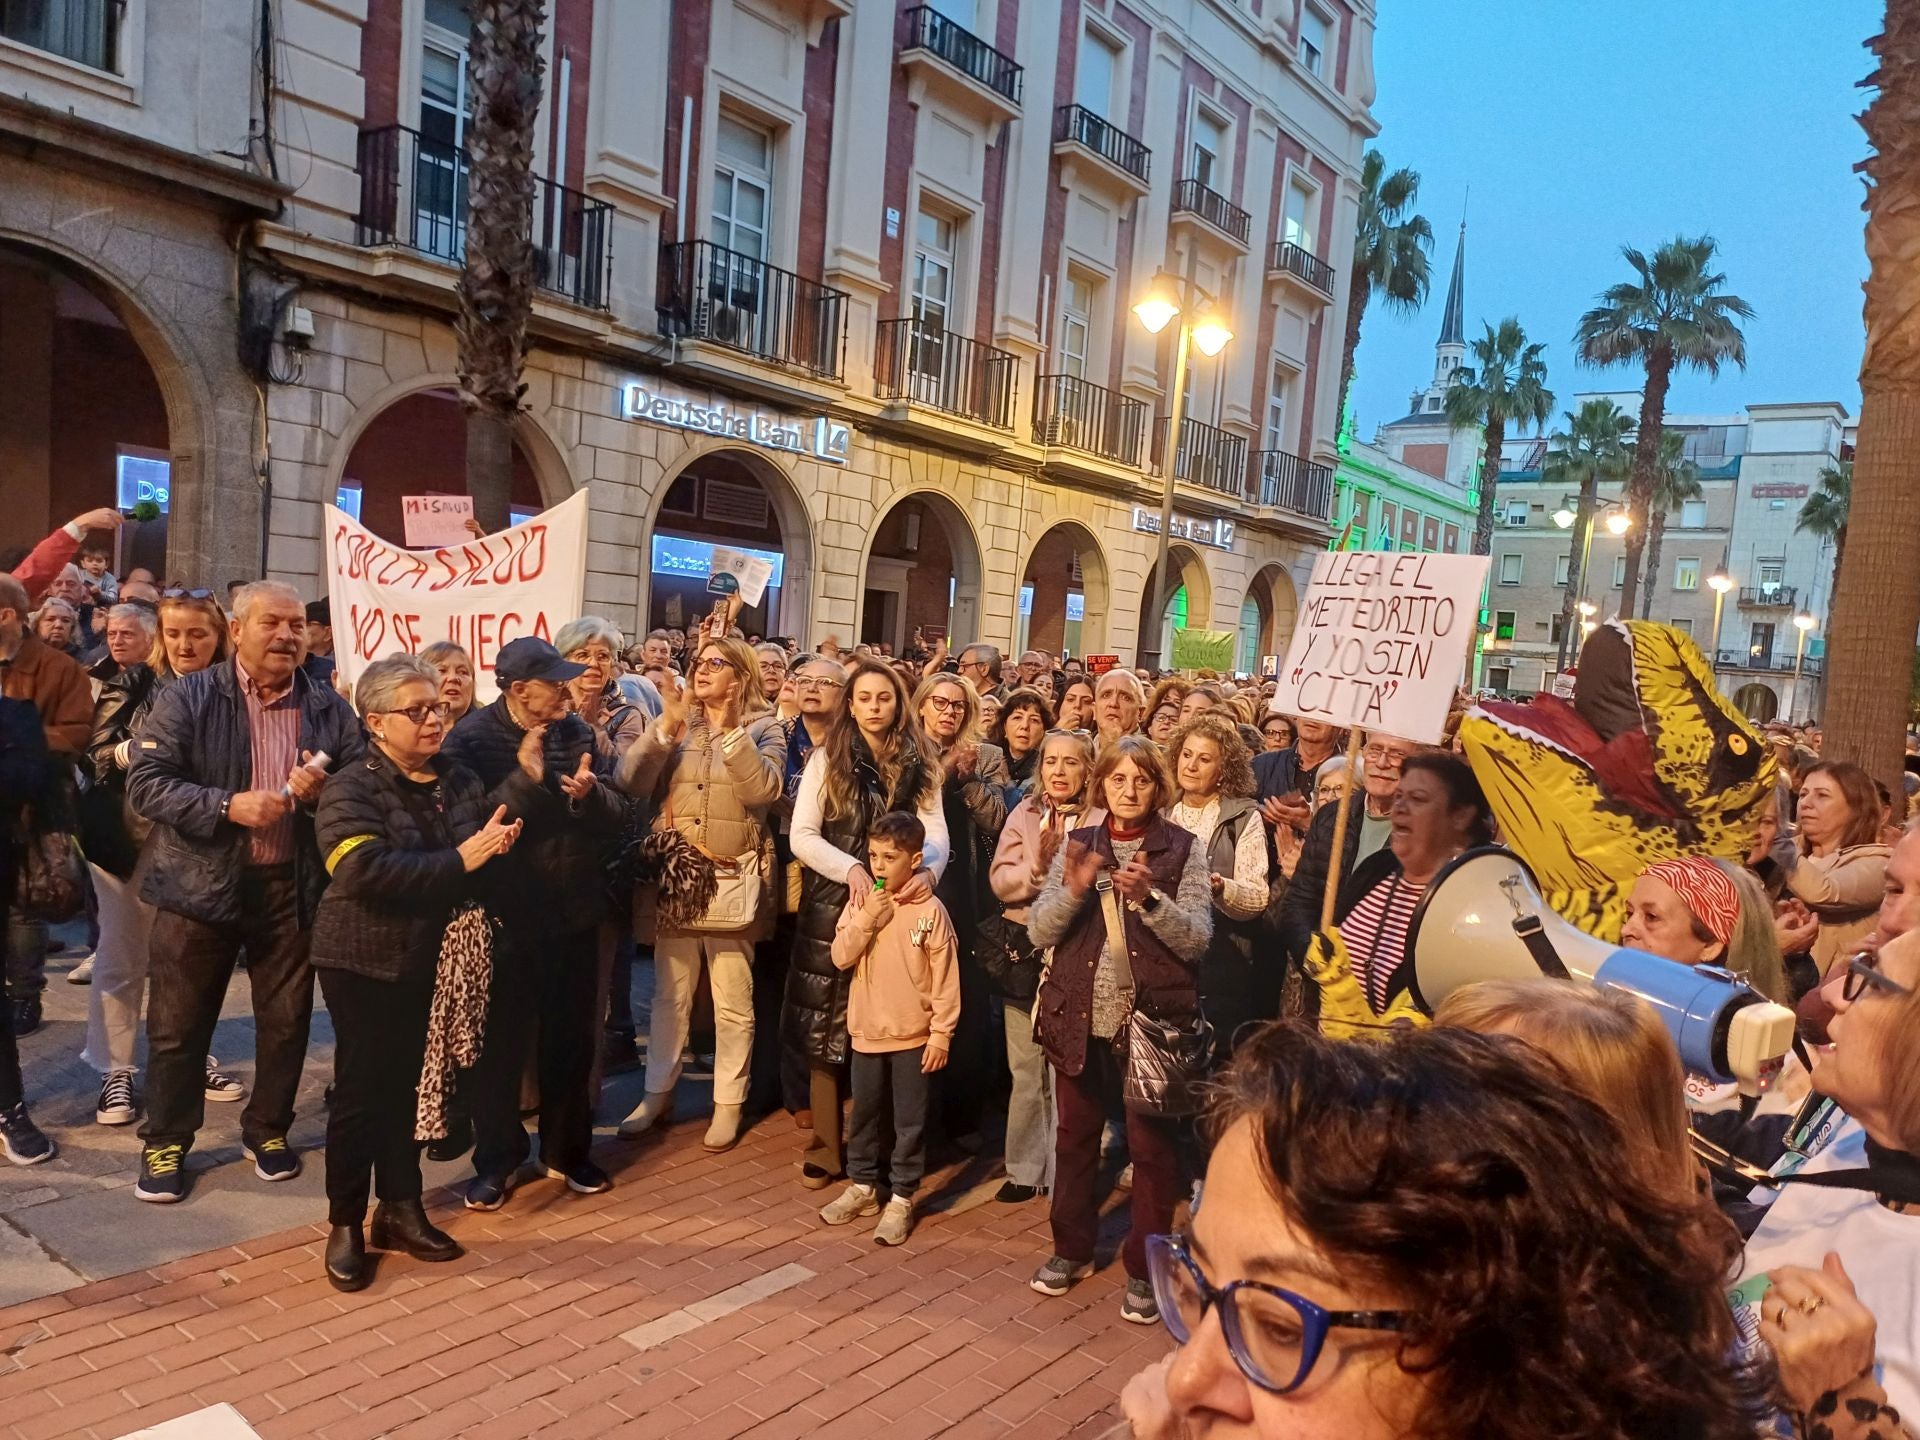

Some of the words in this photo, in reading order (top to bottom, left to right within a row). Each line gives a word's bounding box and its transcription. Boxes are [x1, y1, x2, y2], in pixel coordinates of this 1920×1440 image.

[631, 386, 747, 437] Deutsche
[1138, 509, 1188, 538] Deuche
[429, 524, 548, 592] SALUD
[1313, 553, 1383, 587] LLEGA
[1390, 555, 1433, 590] EL
[350, 604, 385, 661] NO
[1302, 596, 1455, 637] METEORITO
[1300, 632, 1318, 666] Y
[1324, 634, 1365, 676] YO
[1365, 639, 1434, 680] SIN
